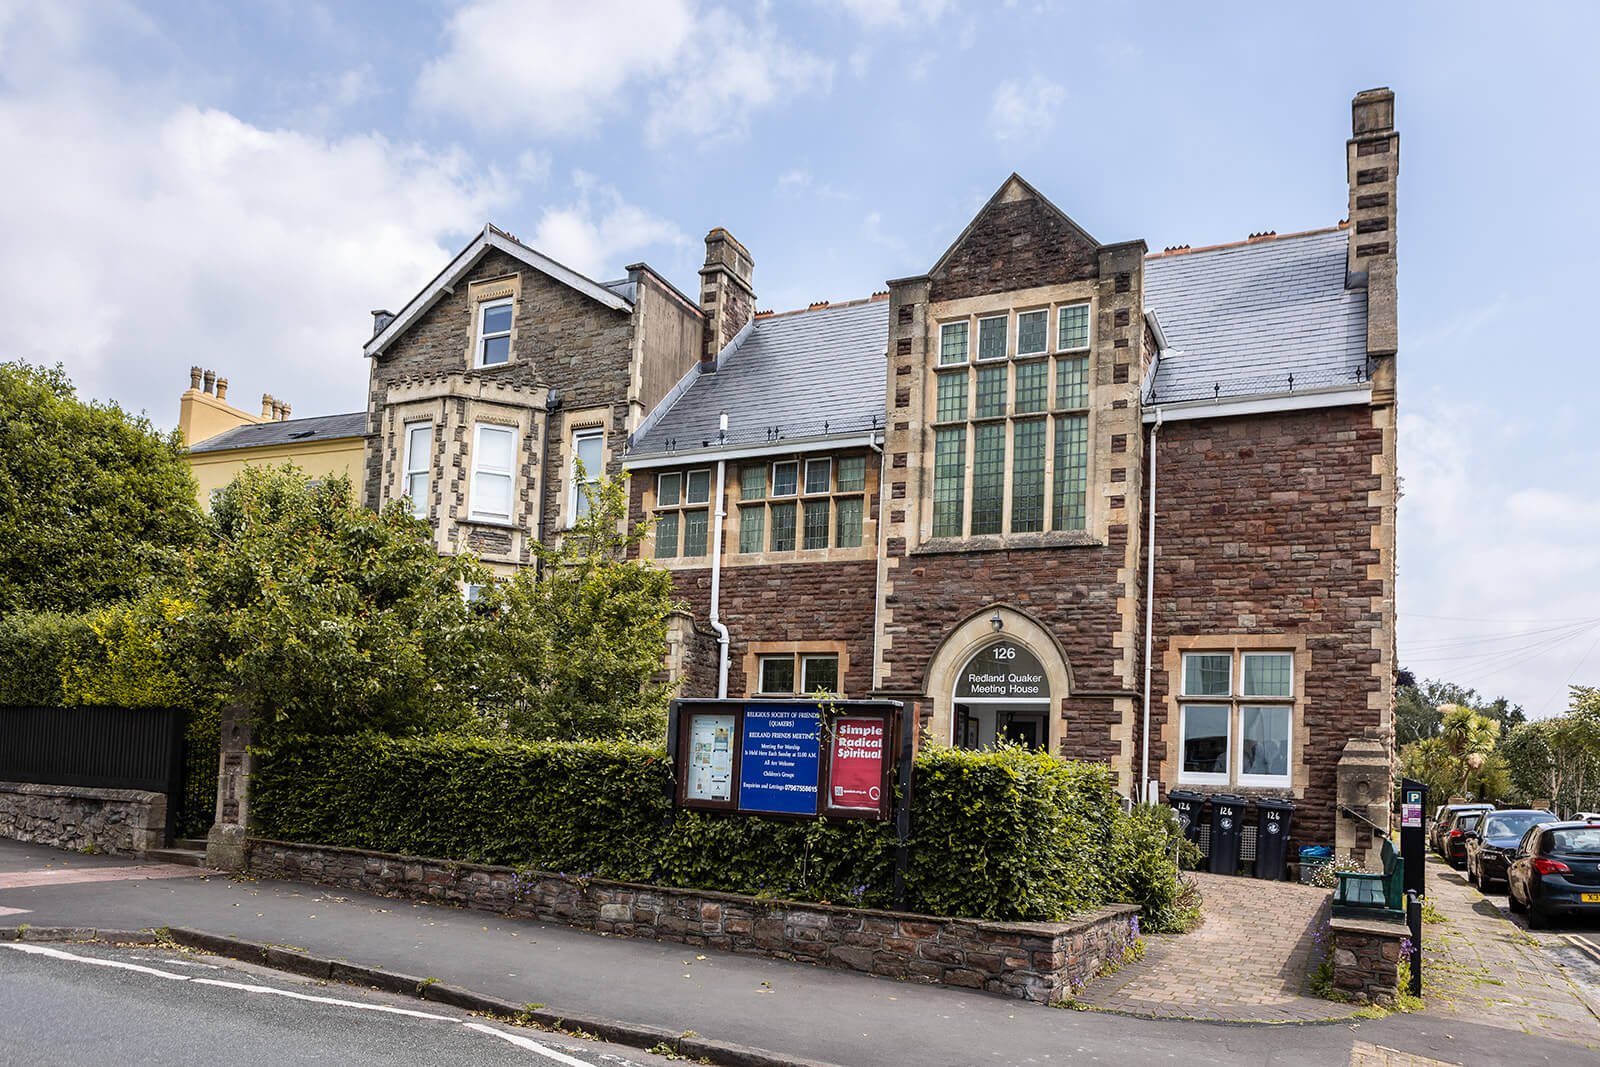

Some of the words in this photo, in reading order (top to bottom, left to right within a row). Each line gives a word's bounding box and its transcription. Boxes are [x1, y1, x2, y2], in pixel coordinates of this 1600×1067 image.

[993, 648, 1015, 659] 126
[969, 674, 1005, 682] Redland
[1008, 674, 1042, 683] Quaker
[971, 685, 1006, 694] Meeting
[1009, 685, 1039, 693] House
[839, 725, 882, 736] Simple
[839, 737, 882, 748] Radical
[838, 748, 882, 759] Spiritual
[1178, 802, 1190, 811] 126
[1220, 807, 1232, 816] 126
[1267, 811, 1280, 820] 126
